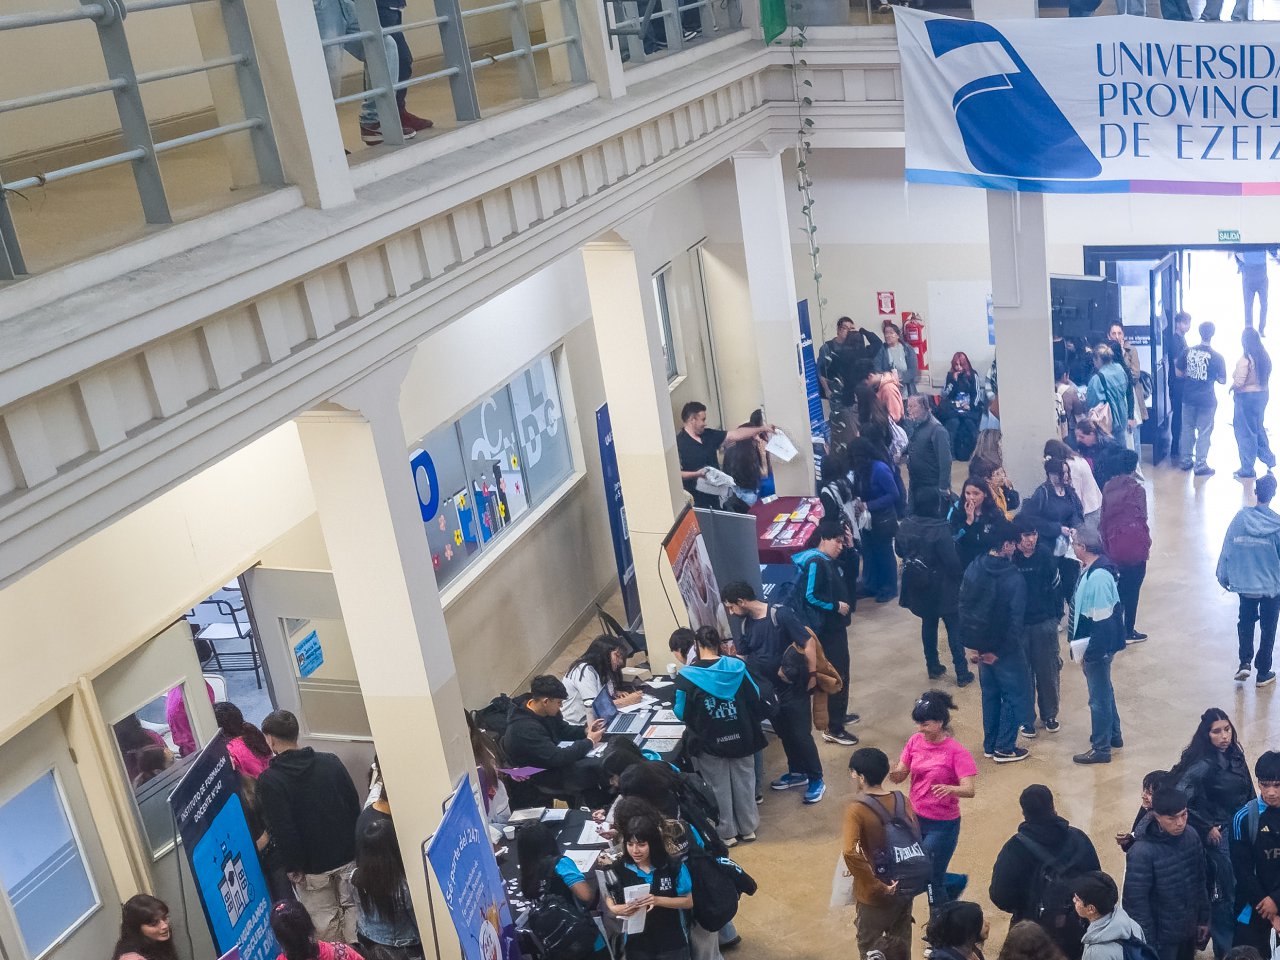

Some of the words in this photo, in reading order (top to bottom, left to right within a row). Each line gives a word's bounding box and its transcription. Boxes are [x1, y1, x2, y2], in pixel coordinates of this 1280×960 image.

[1100, 123, 1152, 159] DE
[1218, 231, 1240, 241] SALIDA
[180, 792, 200, 822] INSTITUTO
[199, 784, 206, 796] DE
[204, 755, 227, 789] FORMACIÓN
[194, 795, 212, 823] DOCENTE
[450, 848, 460, 885] parte
[459, 830, 469, 851] del
[893, 841, 925, 863] EVERLAST
